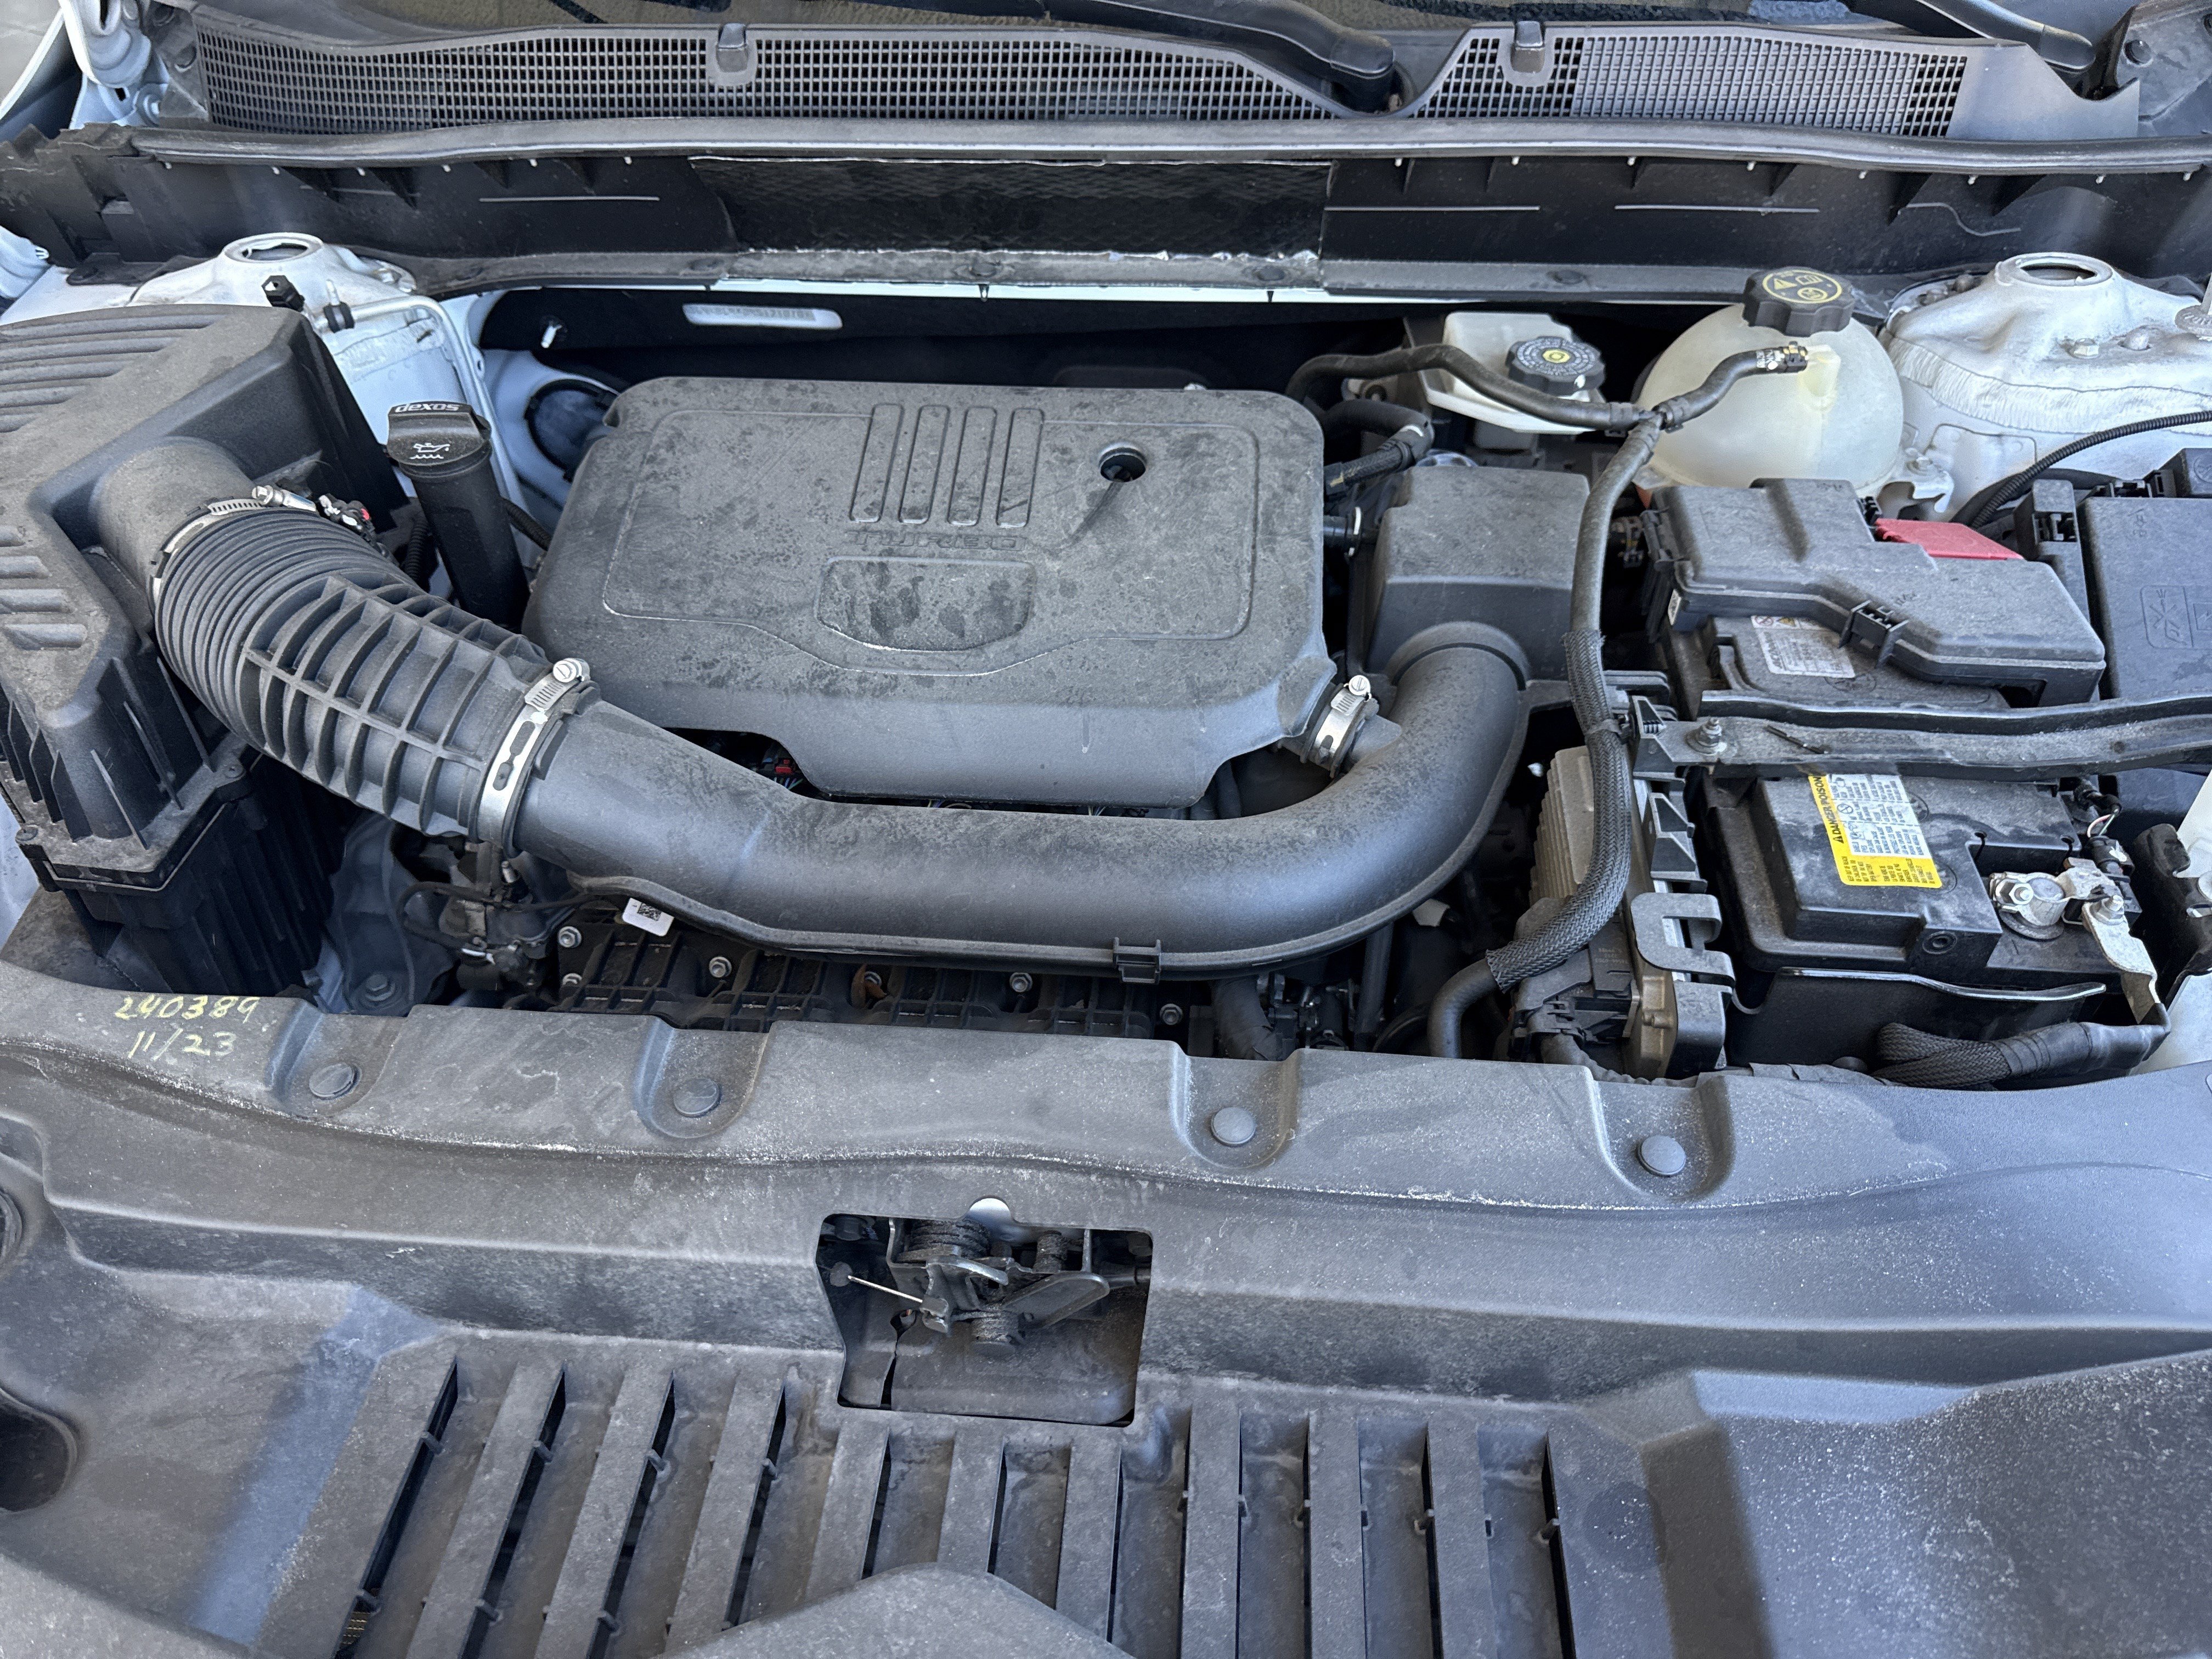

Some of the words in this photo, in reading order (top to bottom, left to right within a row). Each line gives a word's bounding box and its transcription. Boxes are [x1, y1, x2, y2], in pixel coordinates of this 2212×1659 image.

[395, 403, 462, 413] dexos
[845, 530, 1026, 551] TURBO
[115, 994, 261, 1024] 240389
[128, 1028, 236, 1062] 11/23
